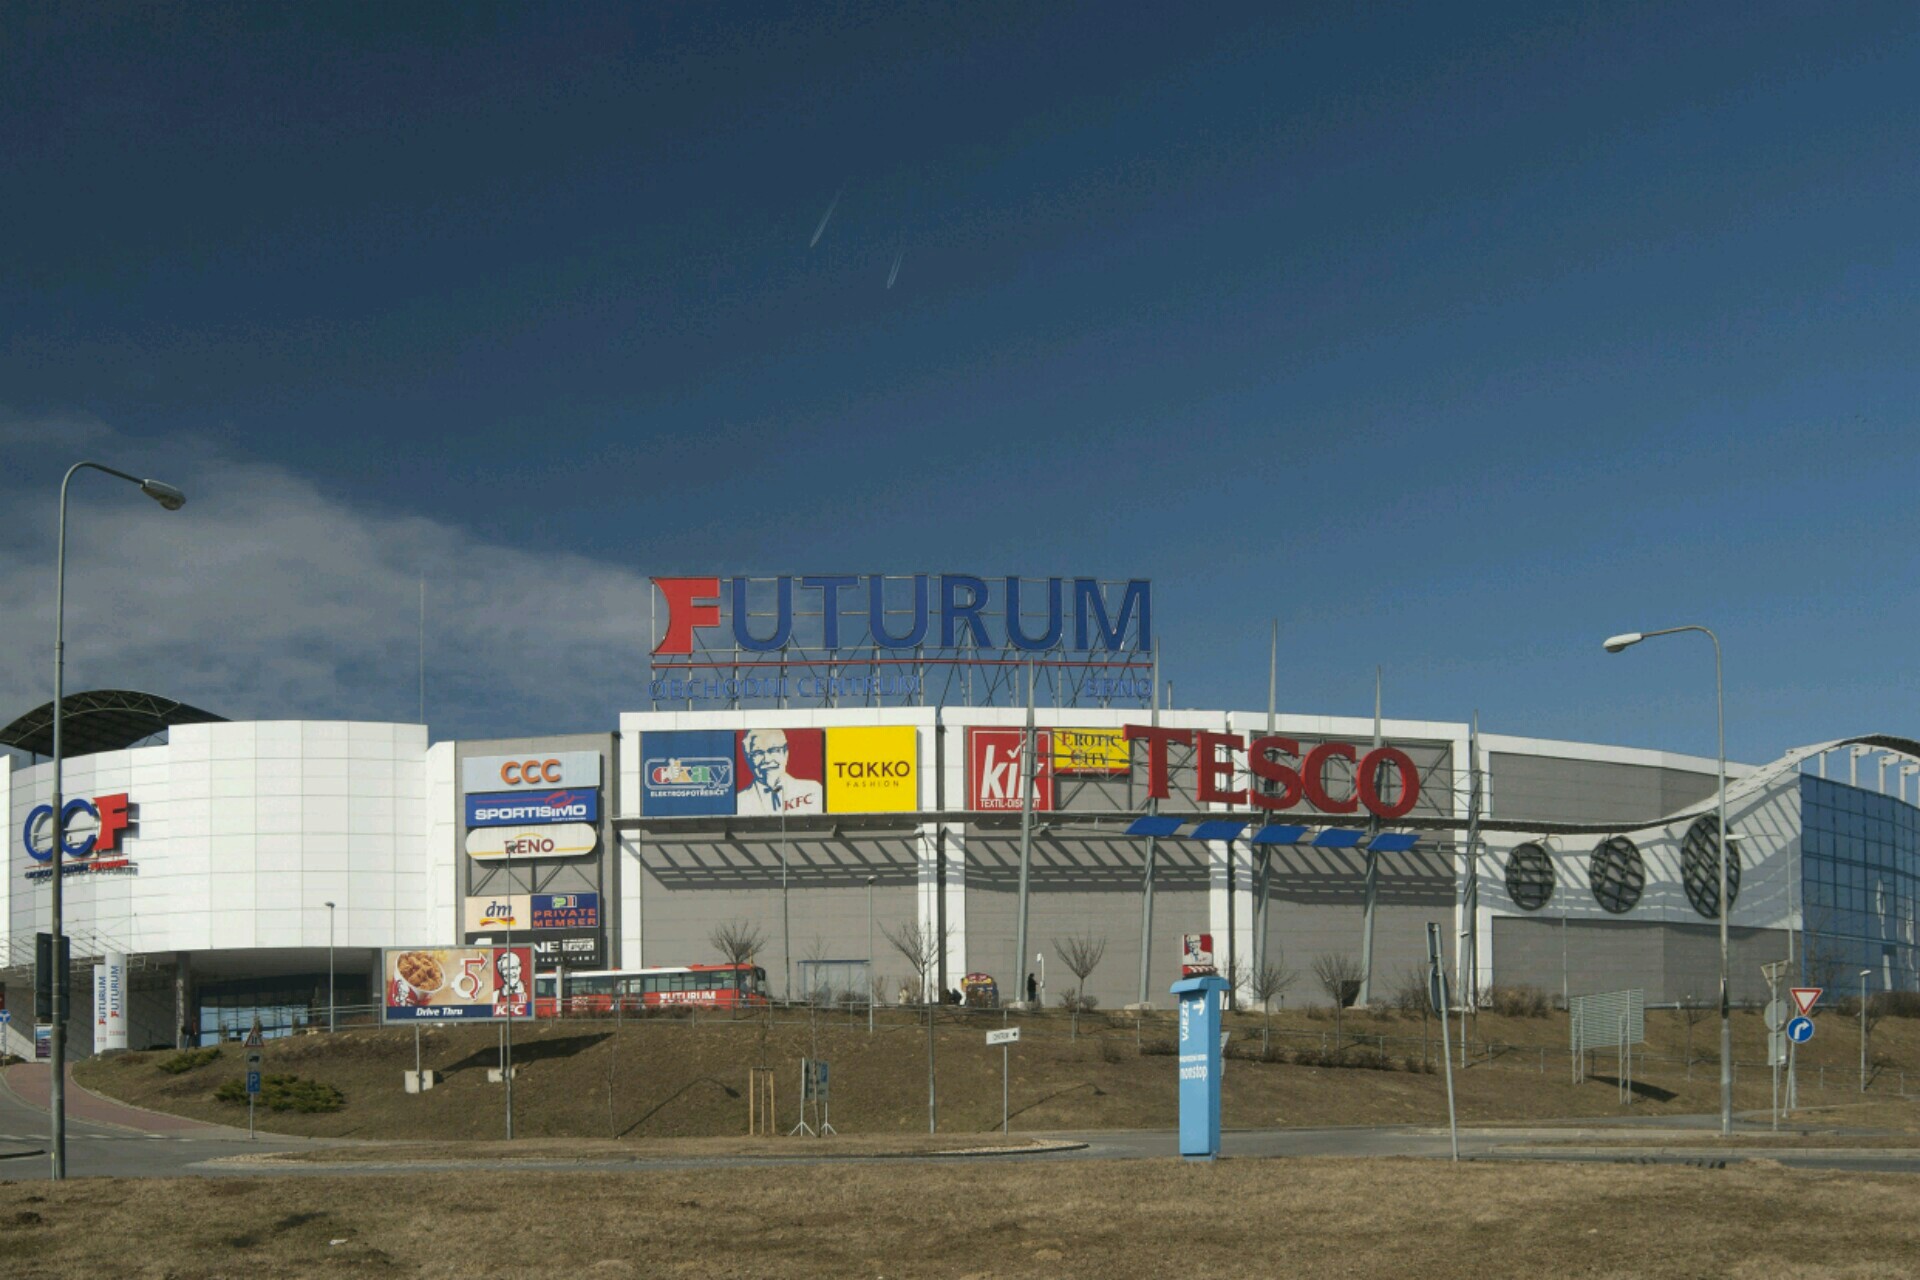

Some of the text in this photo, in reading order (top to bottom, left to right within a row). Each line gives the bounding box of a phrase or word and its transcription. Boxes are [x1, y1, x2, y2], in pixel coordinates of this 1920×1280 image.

[650, 575, 1152, 656] FUTURUM
[797, 673, 922, 697] CENTRUM
[1084, 678, 1153, 698] BRNO
[1060, 730, 1120, 748] EROTIC
[500, 758, 562, 785] CCC
[1123, 723, 1421, 818] TESCO
[846, 780, 900, 788] FASHION
[784, 793, 813, 811] KFC
[504, 838, 555, 854] RENO
[485, 900, 513, 918] dm
[533, 908, 597, 919] PRIVATE
[532, 919, 597, 928] MEMBER
[98, 976, 107, 1025] FUTURUM
[110, 965, 119, 1018] FUTURUM
[659, 991, 716, 1004] FUTURUM
[415, 1006, 464, 1017] Drive Thru
[495, 1005, 525, 1016] KFC
